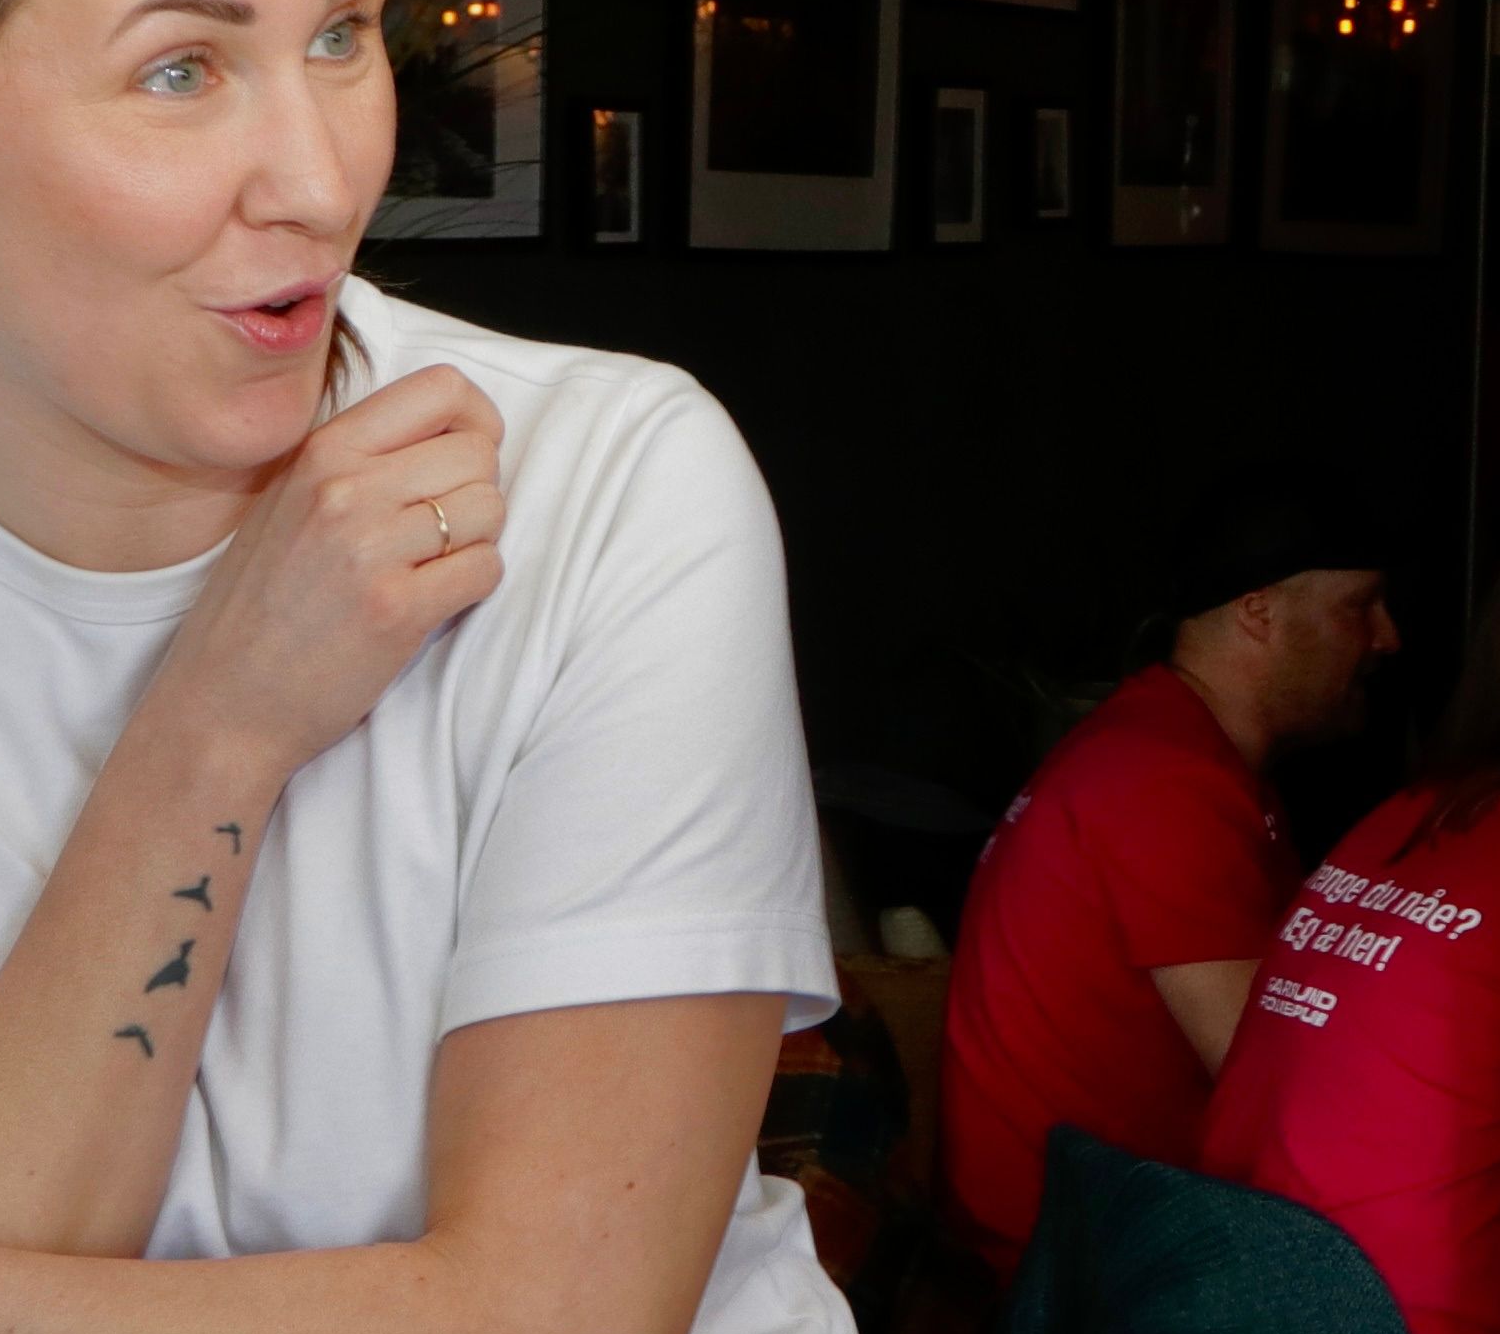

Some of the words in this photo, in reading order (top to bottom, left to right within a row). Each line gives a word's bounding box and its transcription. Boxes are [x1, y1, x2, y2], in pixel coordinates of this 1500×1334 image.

[1357, 880, 1405, 912] du
[1390, 888, 1483, 940] nåe?
[1334, 923, 1402, 972] her!
